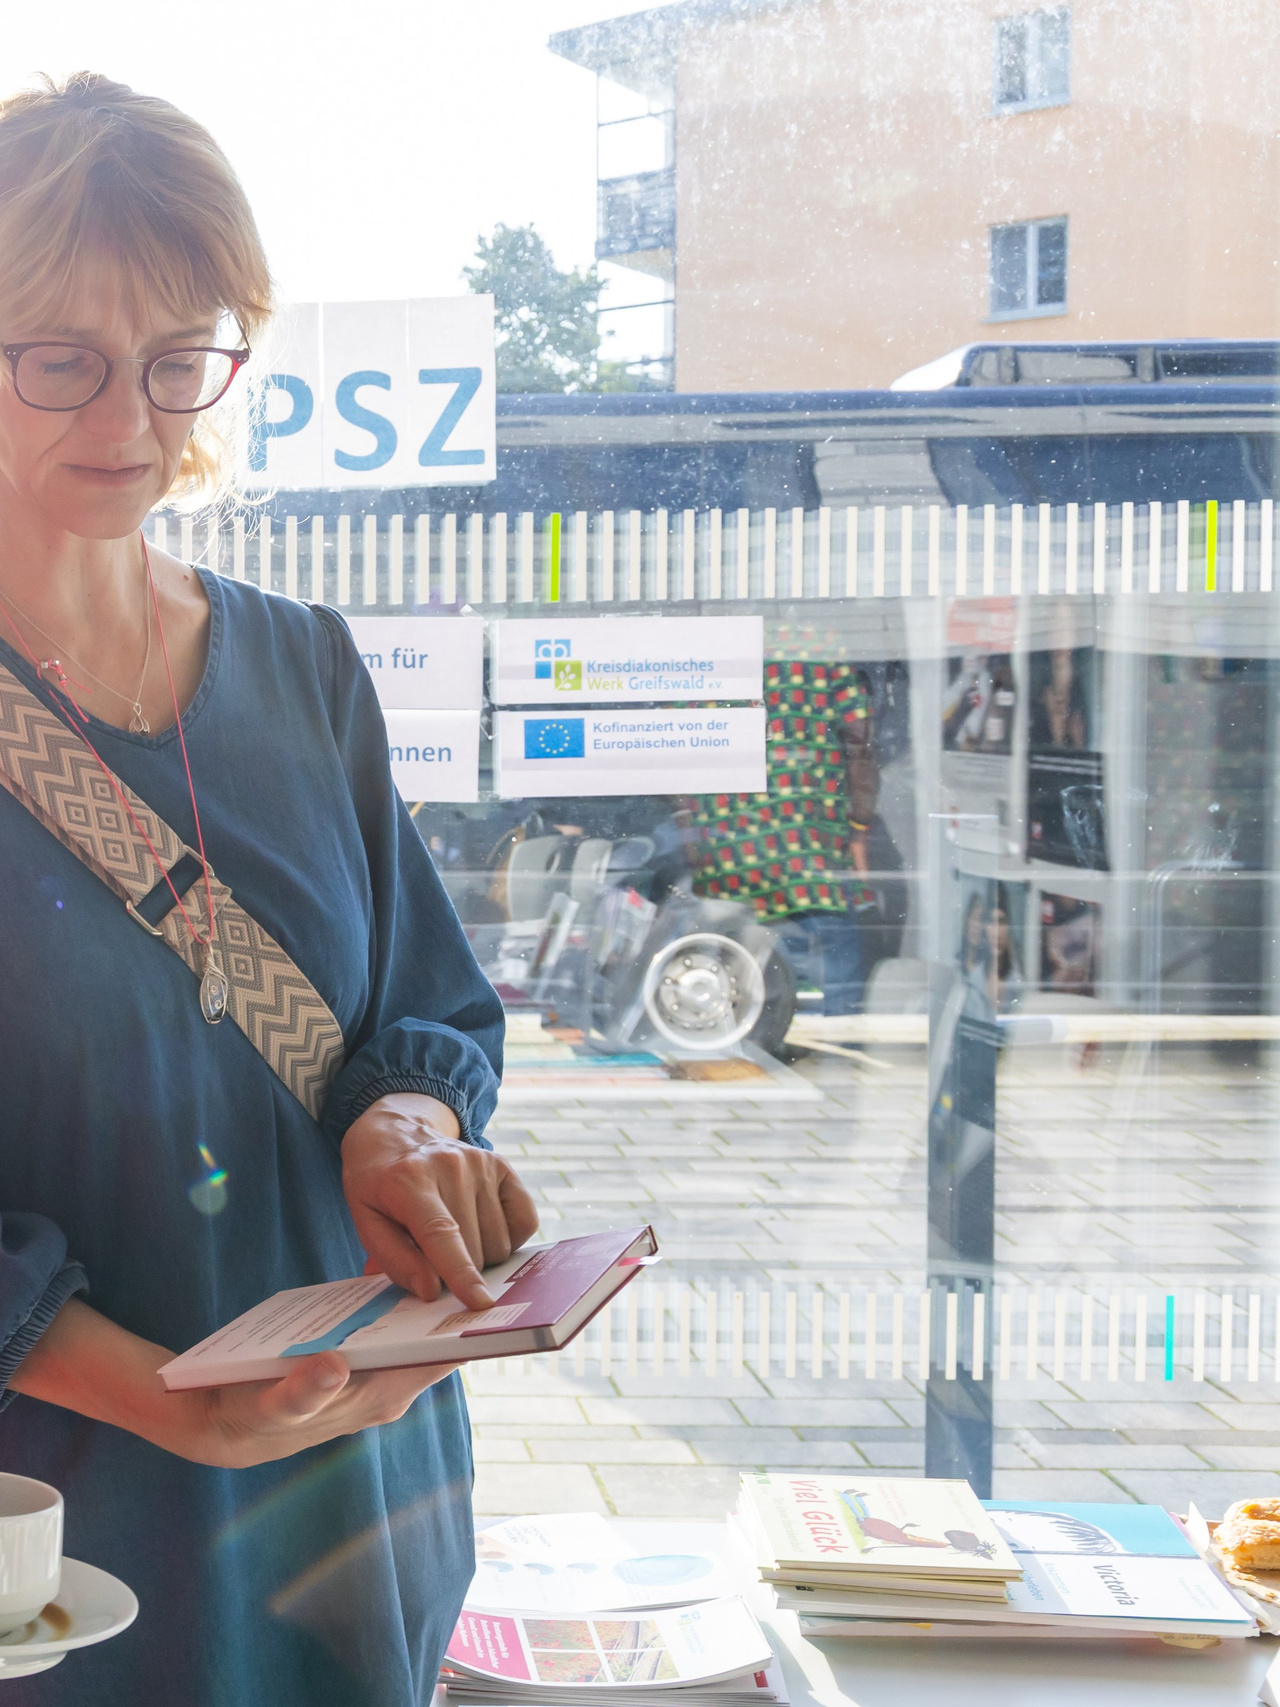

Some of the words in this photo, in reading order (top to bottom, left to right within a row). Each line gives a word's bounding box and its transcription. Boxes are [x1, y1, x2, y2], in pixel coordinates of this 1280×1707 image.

[248, 366, 485, 472] PSZ
[392, 647, 428, 669] für
[587, 658, 714, 674] Kreisdiakonisches
[588, 678, 623, 691] Werk
[629, 675, 704, 691] Greifswald
[708, 681, 724, 690] e.V.
[593, 721, 674, 734] Kofinanziert
[678, 722, 702, 731] von
[707, 720, 729, 731] der
[593, 738, 685, 750] Europäischen
[690, 736, 730, 748] Union
[788, 1480, 828, 1503] Viel
[802, 1511, 849, 1553] Glück
[1093, 1564, 1139, 1606] Victoria
